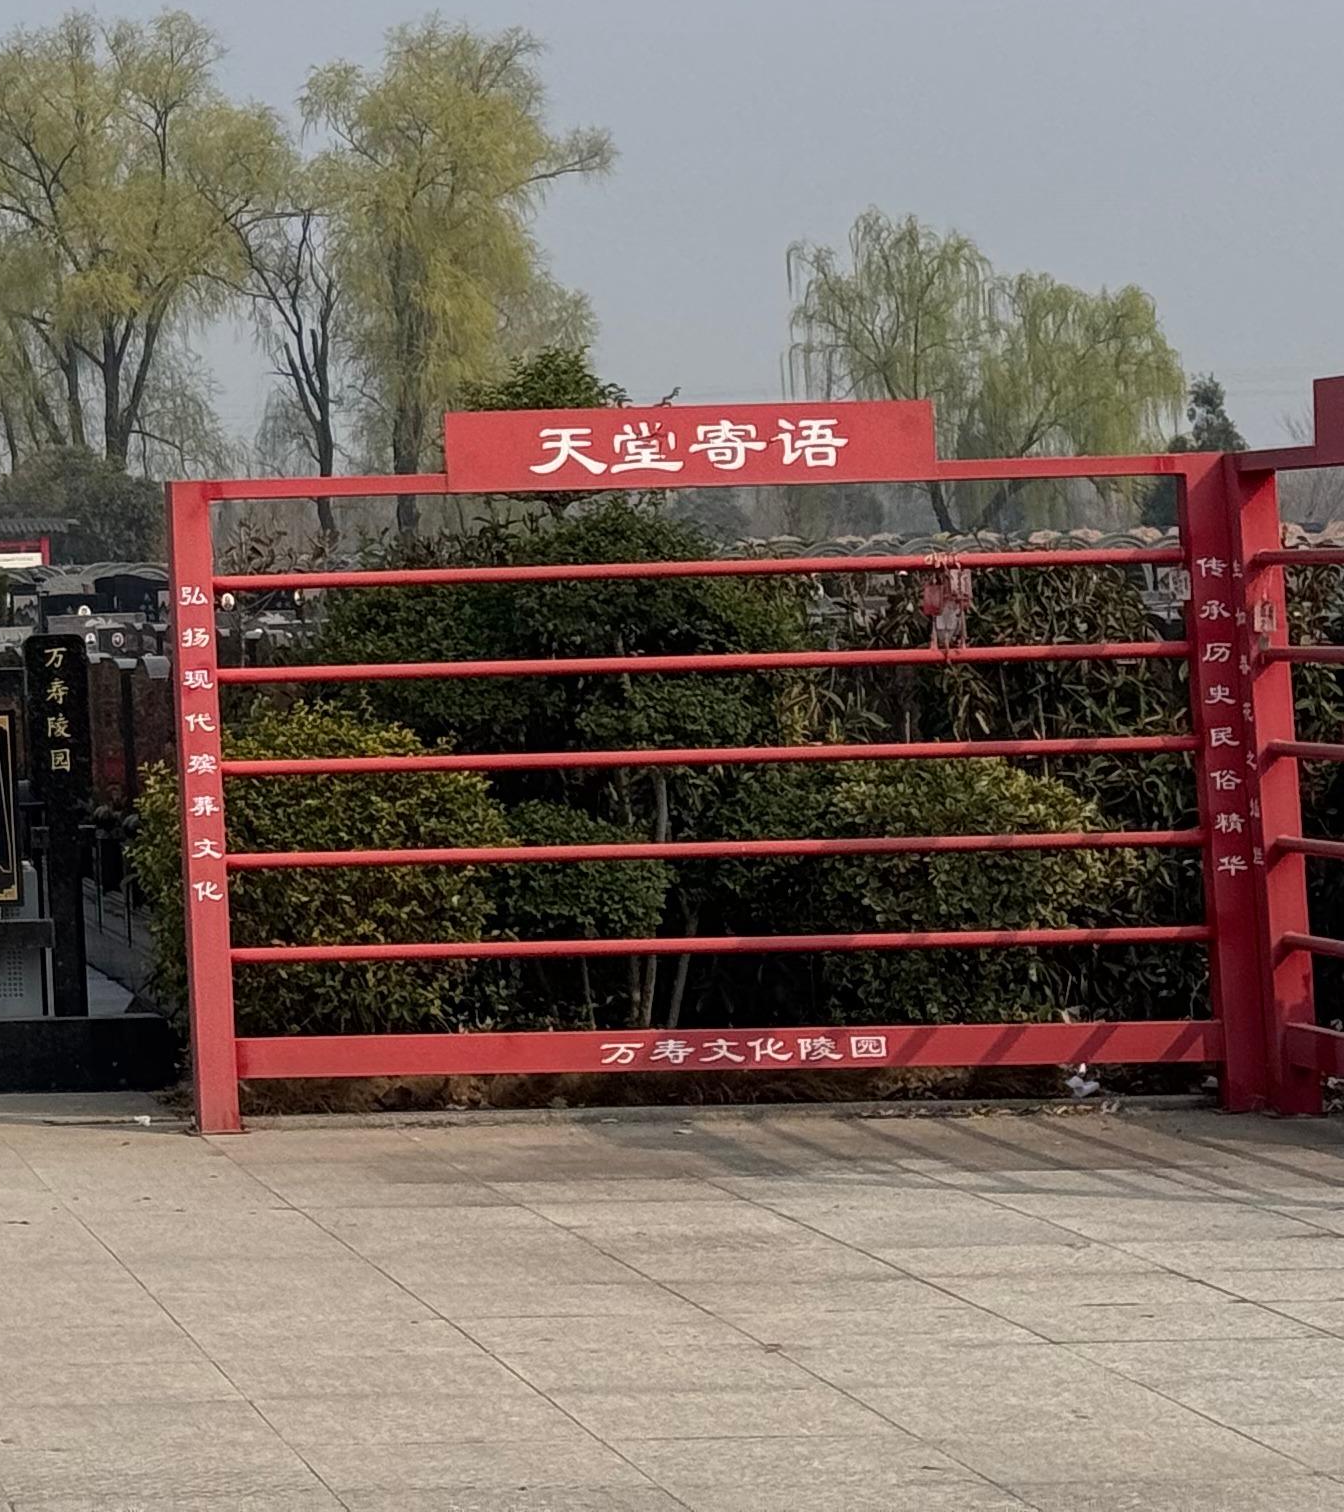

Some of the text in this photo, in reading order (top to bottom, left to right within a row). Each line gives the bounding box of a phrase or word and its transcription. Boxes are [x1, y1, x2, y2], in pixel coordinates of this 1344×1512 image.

[530, 418, 849, 476] 天堂寄语
[44, 647, 72, 772] 万寿陵园
[179, 585, 225, 903] 弘扬现代殡葬文化
[1196, 556, 1248, 876] 传承历史民俗精华
[600, 1034, 889, 1066] 万寿文化陵园
